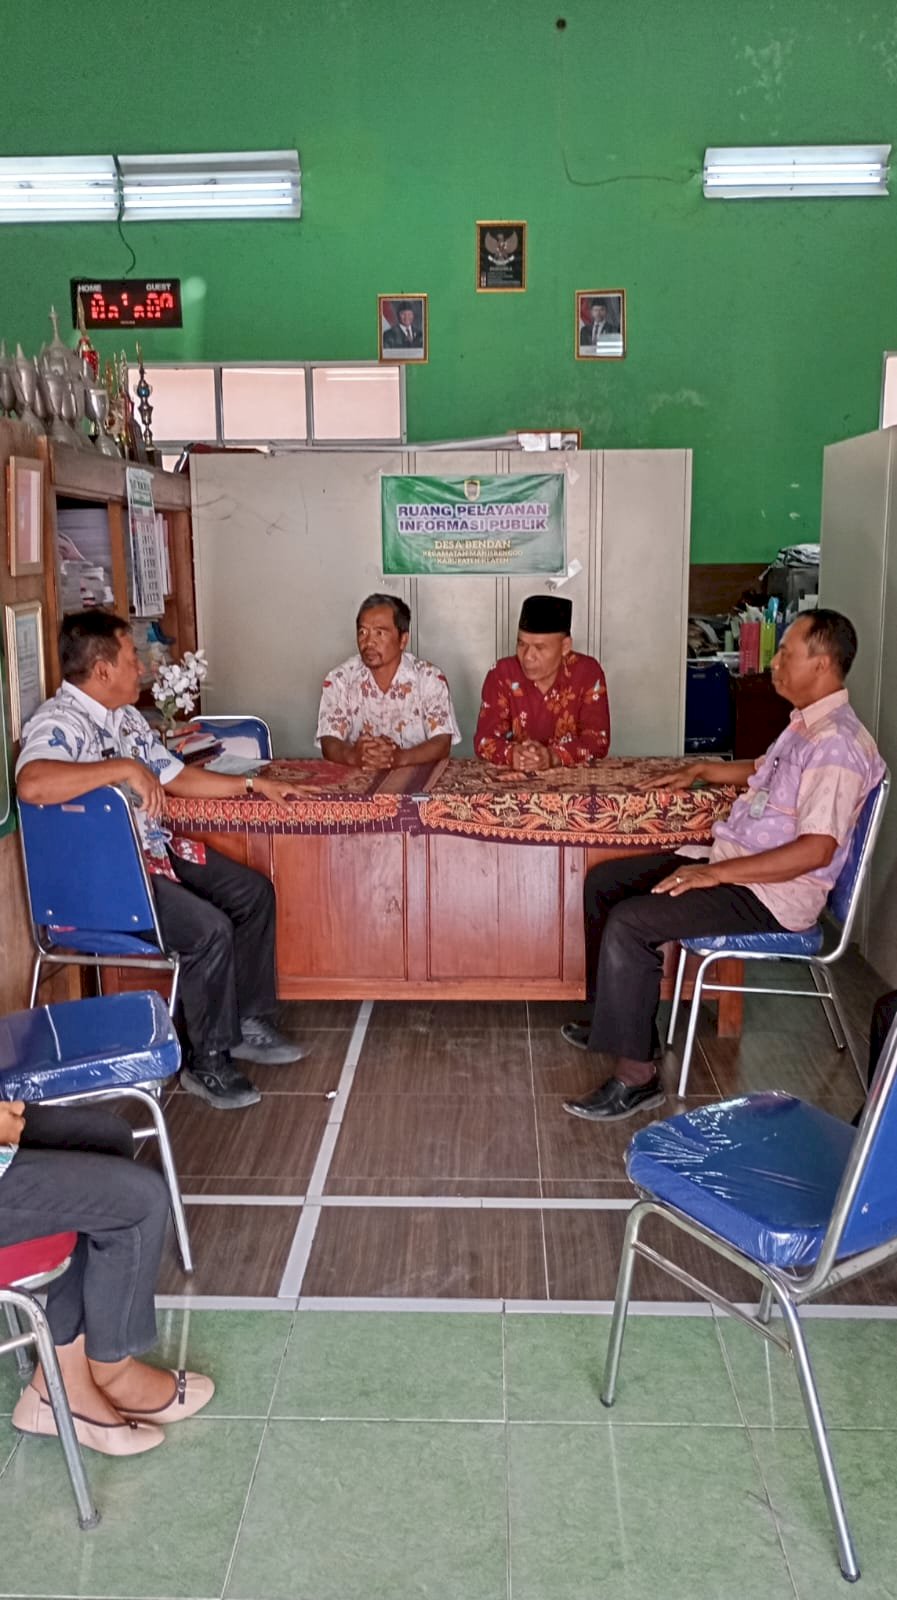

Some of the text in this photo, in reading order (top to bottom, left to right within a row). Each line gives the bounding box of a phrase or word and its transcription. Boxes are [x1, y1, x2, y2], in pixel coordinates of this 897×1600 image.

[78, 284, 102, 292] HOME
[146, 283, 171, 291] GUEST
[398, 504, 547, 517] RUANG PELAYANAN
[399, 519, 546, 531] INFORMASI PUBLIK
[434, 540, 511, 549] DESA BENDAN
